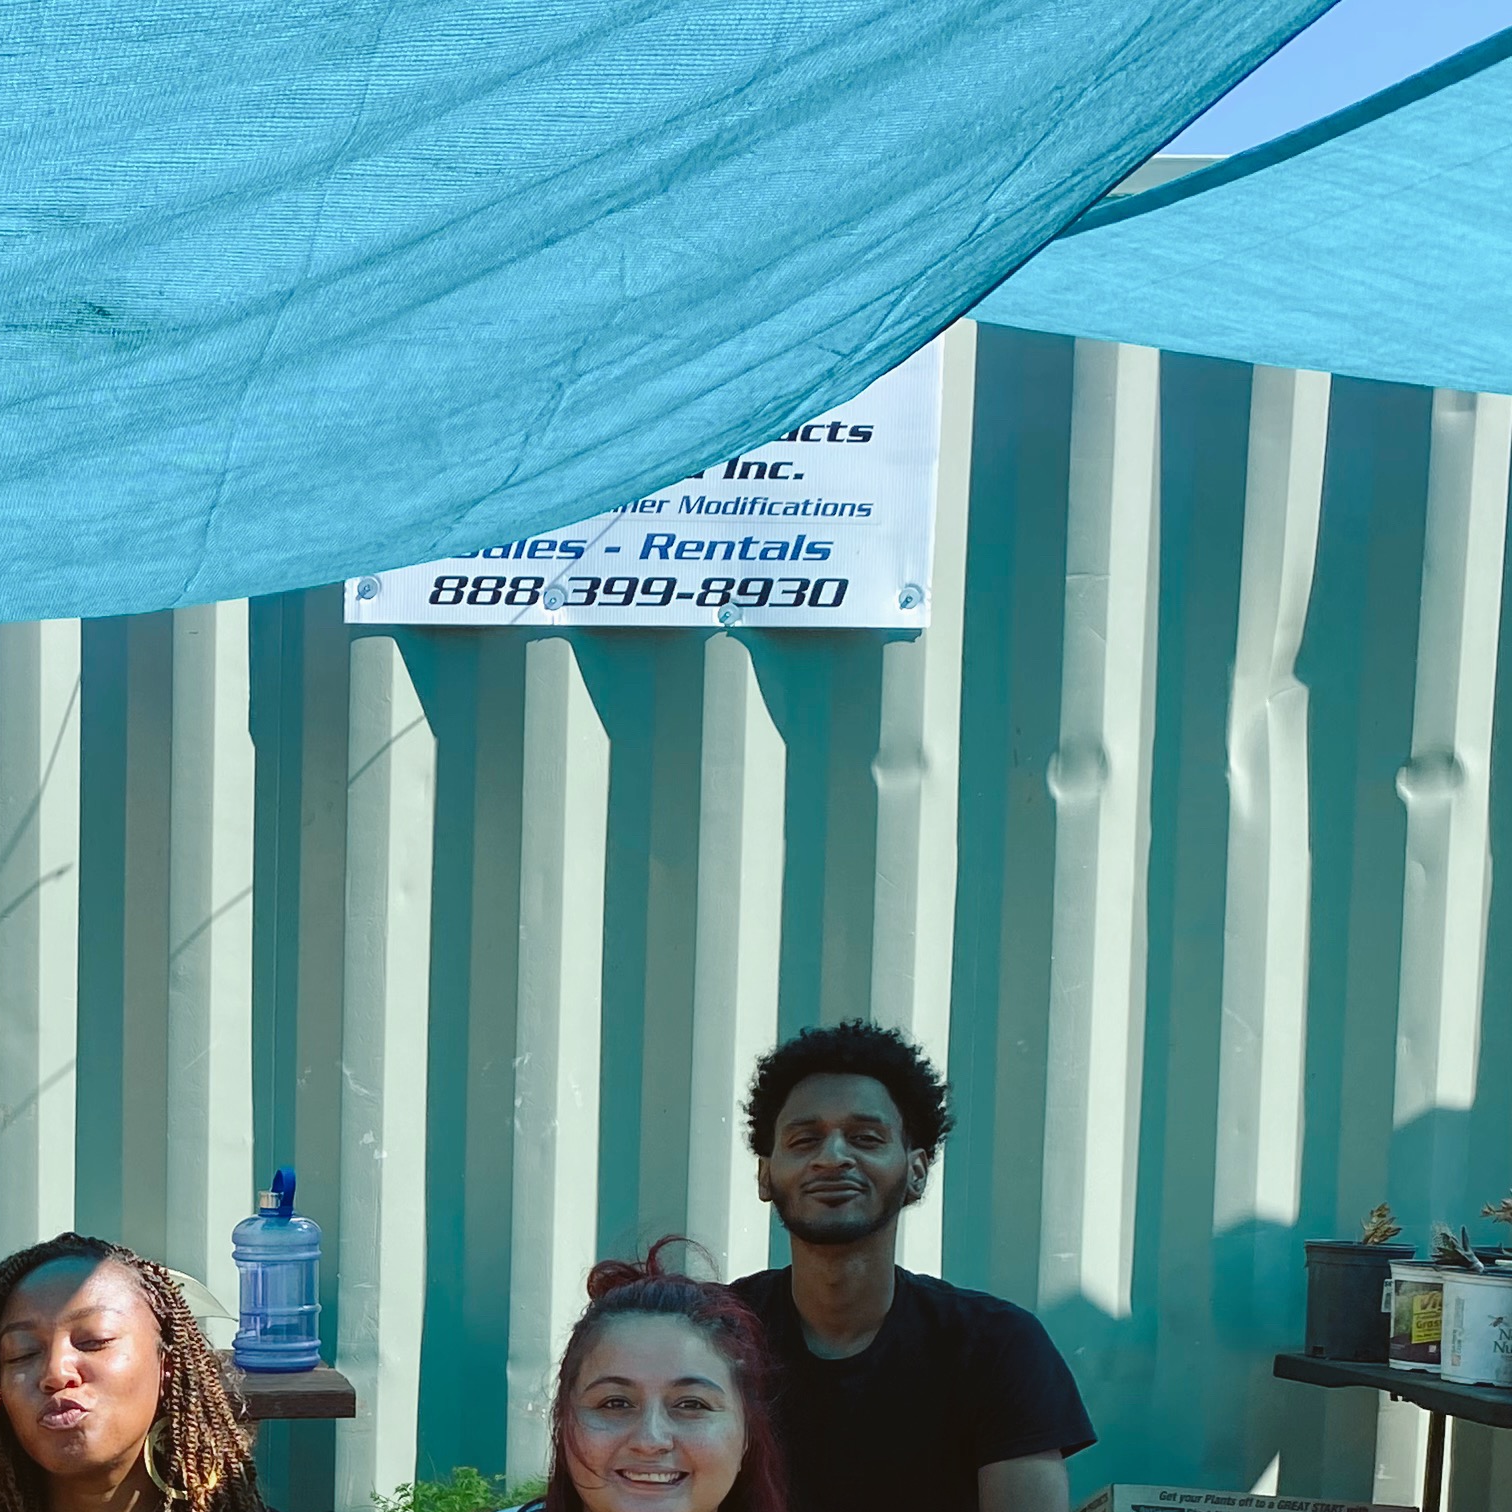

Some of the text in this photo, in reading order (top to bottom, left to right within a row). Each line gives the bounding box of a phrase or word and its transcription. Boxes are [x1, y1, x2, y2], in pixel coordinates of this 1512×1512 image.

[678, 495, 875, 517] Modifications
[451, 538, 587, 560] ales
[639, 532, 834, 562] Rentals
[428, 575, 850, 608] 888399-8930
[1159, 1491, 1176, 1501] Get
[1178, 1493, 1202, 1504] your
[1204, 1494, 1236, 1506] Plants
[1239, 1497, 1255, 1507] off
[1255, 1499, 1266, 1508] to
[1277, 1500, 1311, 1511] GREAT
